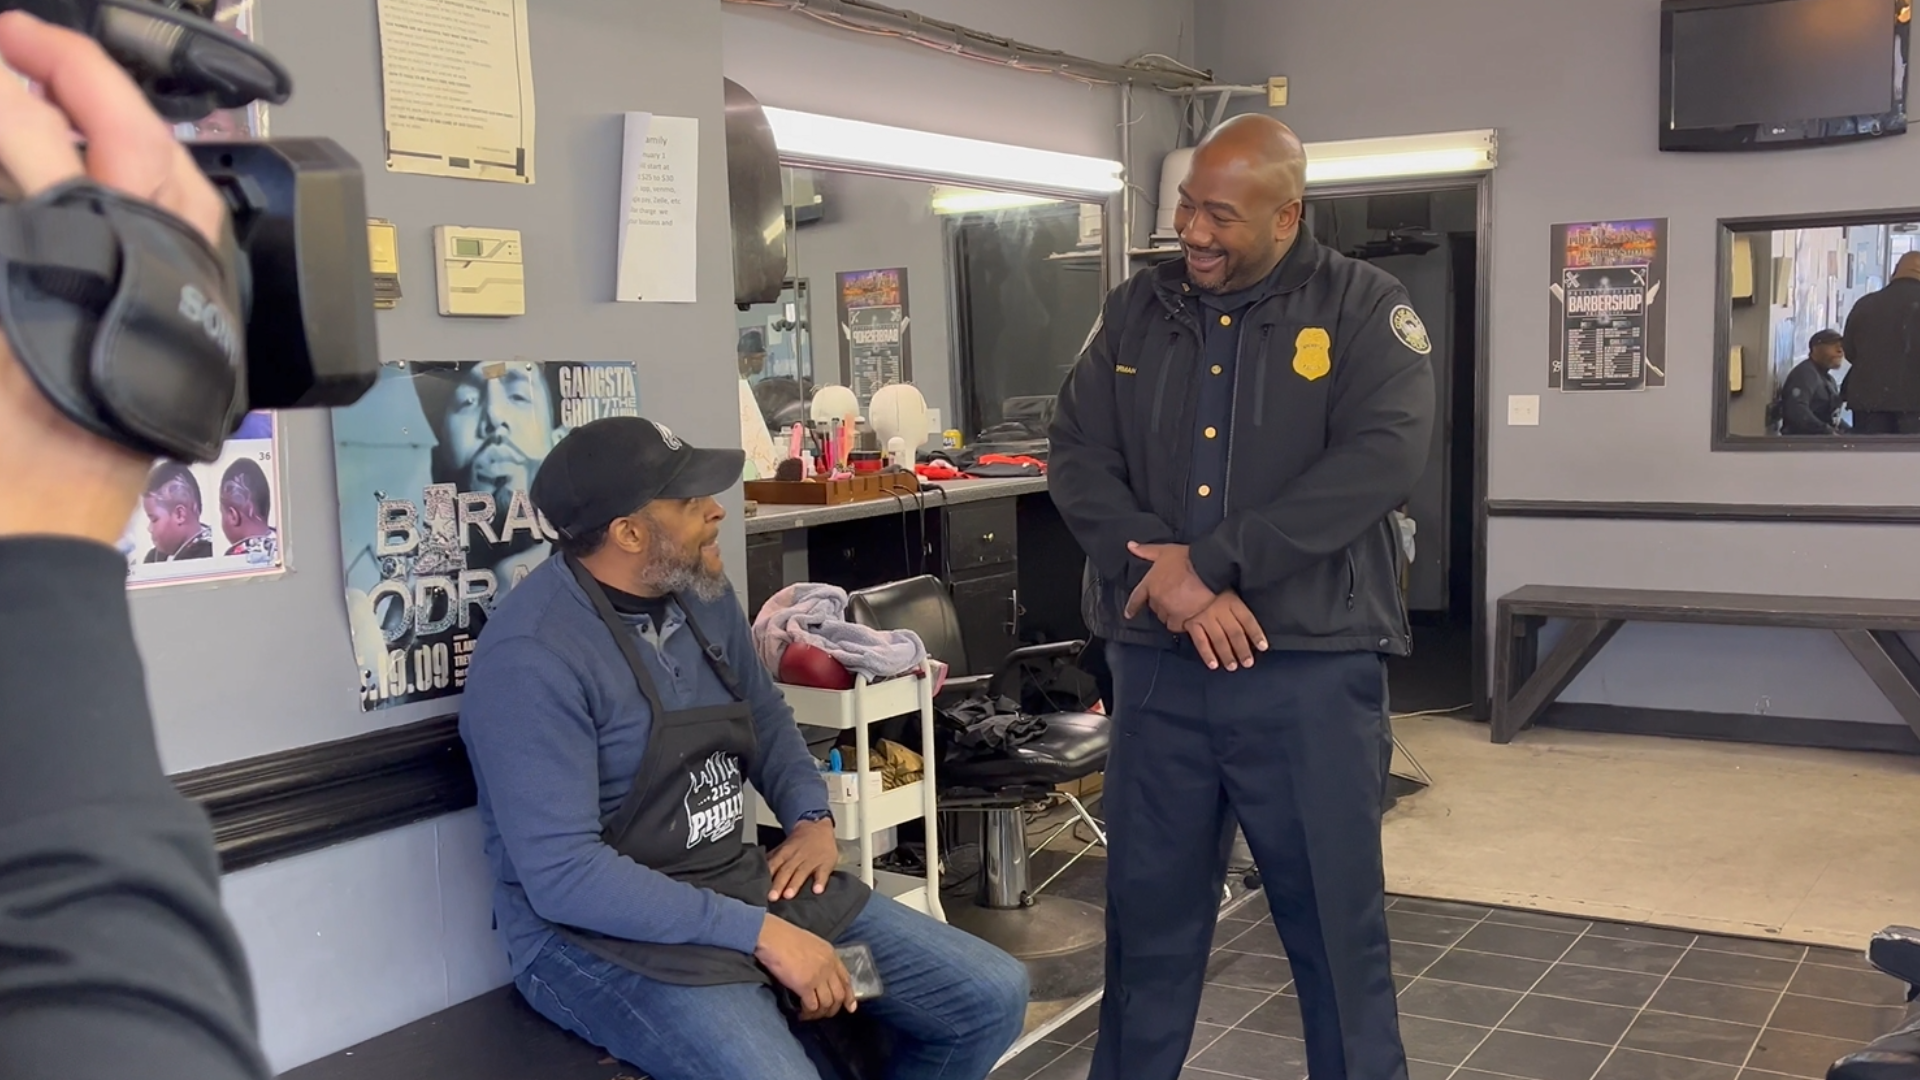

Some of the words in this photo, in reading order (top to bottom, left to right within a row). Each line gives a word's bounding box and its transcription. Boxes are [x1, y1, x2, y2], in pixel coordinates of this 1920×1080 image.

[1569, 294, 1641, 312] BARBERSHOP
[559, 366, 636, 398] GANGSTA
[612, 397, 637, 408] THE
[258, 451, 271, 461] 36
[711, 781, 731, 801] 215
[846, 787, 852, 797] L
[690, 792, 744, 843] PHILLY
